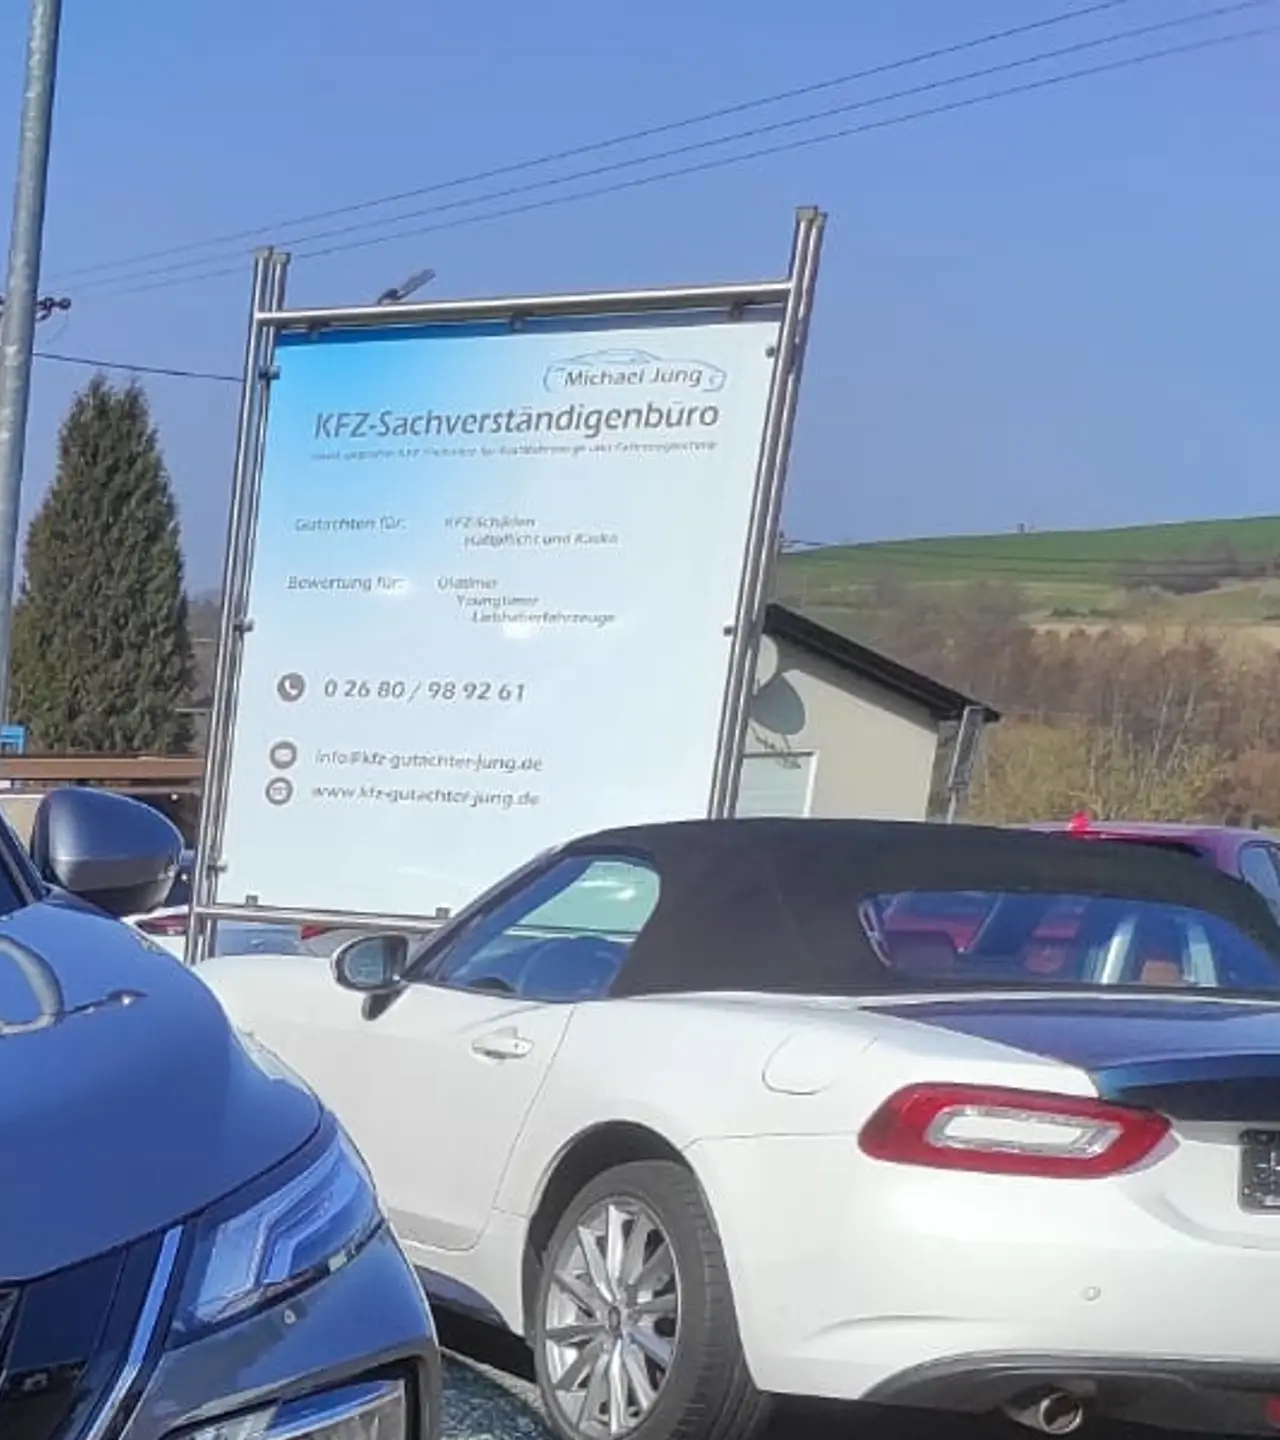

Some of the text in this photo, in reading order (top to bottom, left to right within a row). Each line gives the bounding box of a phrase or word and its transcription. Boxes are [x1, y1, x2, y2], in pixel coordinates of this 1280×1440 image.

[563, 367, 645, 388] Michael
[314, 399, 720, 441] KFZ-Sachverständigenbüro
[288, 576, 371, 592] Bewertung
[344, 680, 370, 698] 26
[378, 681, 405, 699] 80
[428, 681, 456, 699] 98
[464, 682, 491, 700] 92
